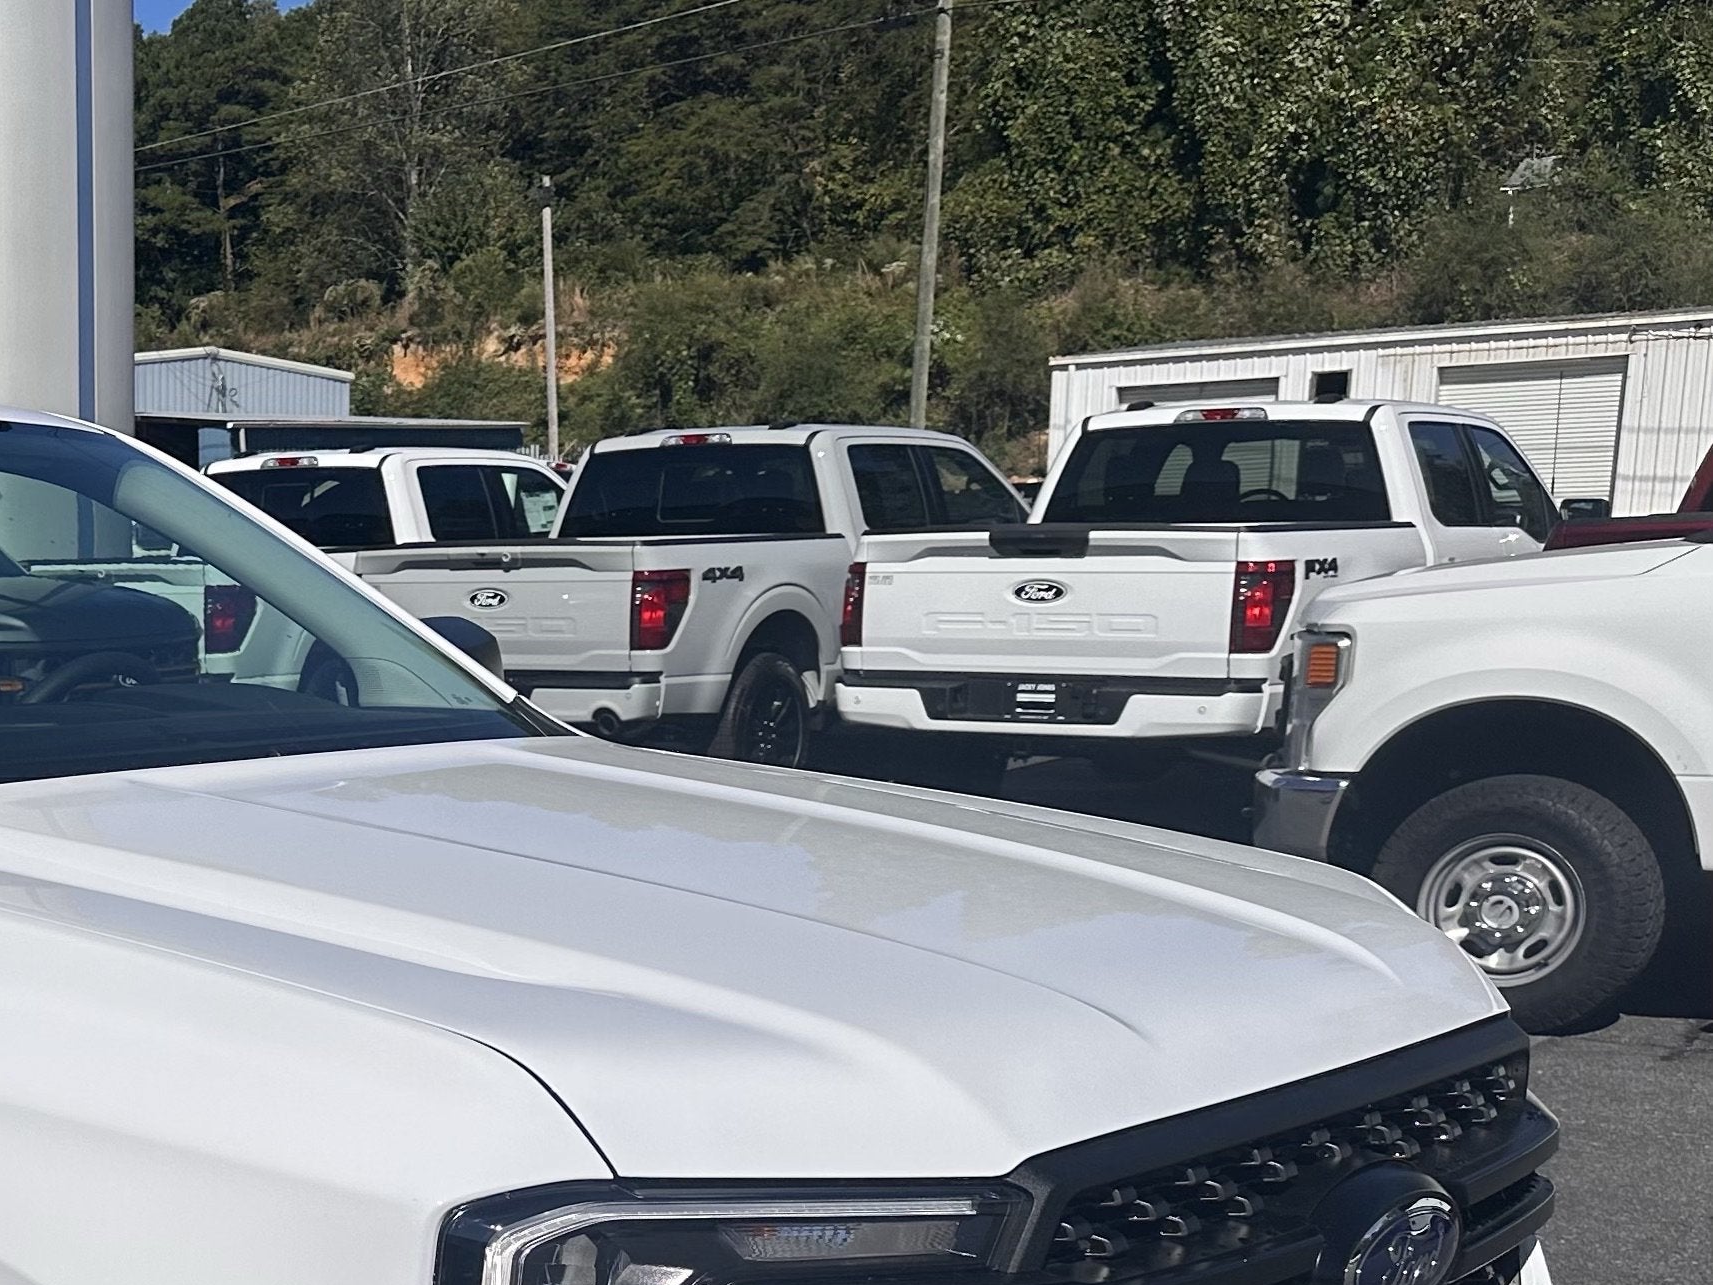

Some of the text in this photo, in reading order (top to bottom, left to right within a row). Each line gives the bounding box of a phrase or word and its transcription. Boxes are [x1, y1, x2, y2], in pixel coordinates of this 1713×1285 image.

[472, 592, 503, 607] Ford
[1018, 583, 1059, 602] Ford
[921, 611, 1159, 638] F-150
